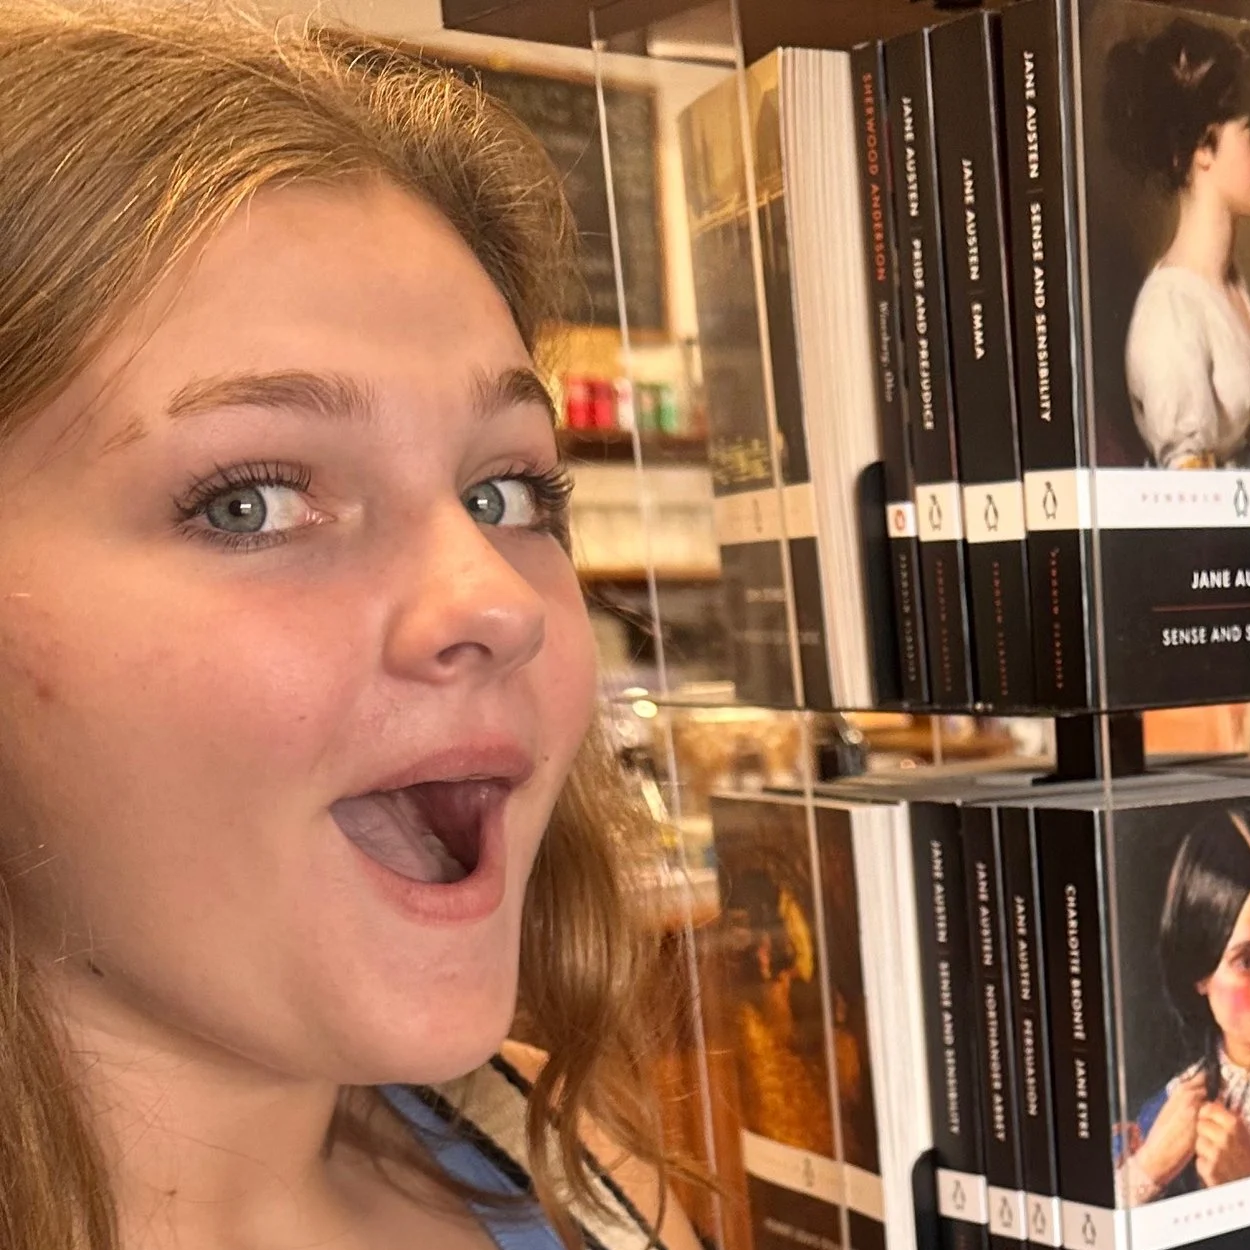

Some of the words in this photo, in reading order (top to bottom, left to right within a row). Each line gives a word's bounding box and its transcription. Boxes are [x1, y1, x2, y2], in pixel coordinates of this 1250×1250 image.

[1023, 51, 1036, 100] JANE
[902, 96, 915, 141] JANE
[1025, 104, 1039, 179] AUSTEN
[862, 73, 877, 176] SHERWOOD
[870, 184, 888, 282] ANDERSON
[905, 147, 919, 217] AUSTEN
[962, 158, 975, 205] JANE
[965, 209, 980, 281] AUSTEN
[1030, 202, 1044, 261] SENSE
[912, 238, 925, 289] PRIDE
[1033, 266, 1046, 309] AND
[915, 295, 927, 334] AND
[971, 303, 985, 360] EMMA
[919, 338, 934, 430] PREJUDICE
[1035, 314, 1051, 422] SENSIBILITY
[1191, 568, 1231, 590] JANE
[1162, 628, 1207, 647] SENSE
[1210, 625, 1241, 643] AND
[929, 840, 944, 879] JANE
[975, 862, 989, 901] JANE
[933, 882, 948, 943] AUSTEN
[979, 904, 994, 966] AUSTEN
[1015, 895, 1027, 936] JANE
[1065, 884, 1081, 975] CHARLOTTE
[1017, 938, 1031, 1001] AUSTEN
[1024, 1018, 1038, 1117] PERSUASION
[1075, 1058, 1088, 1099] JANE
[1077, 1101, 1090, 1140] EYRE
